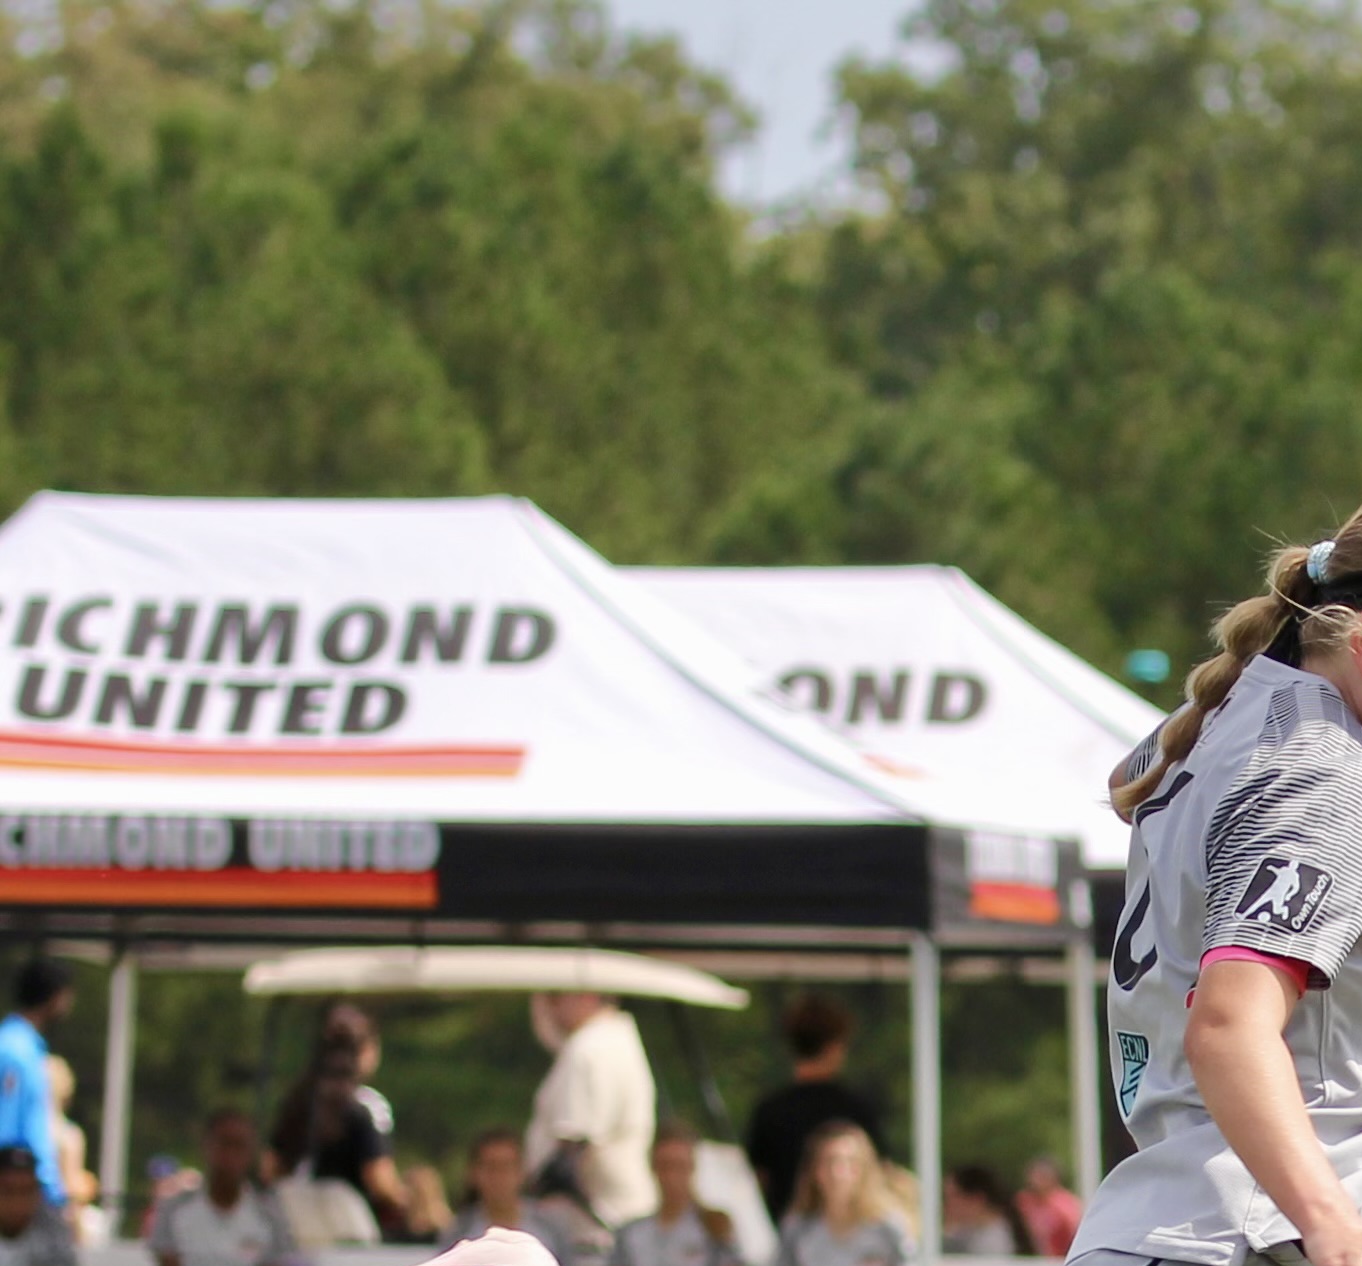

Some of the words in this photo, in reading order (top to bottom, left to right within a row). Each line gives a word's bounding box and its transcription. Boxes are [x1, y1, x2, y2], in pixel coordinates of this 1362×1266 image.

[0, 597, 557, 665] ICHMOND
[15, 666, 407, 735] UNITED
[248, 819, 441, 873] UNITED
[1119, 1035, 1148, 1061] ECNL
